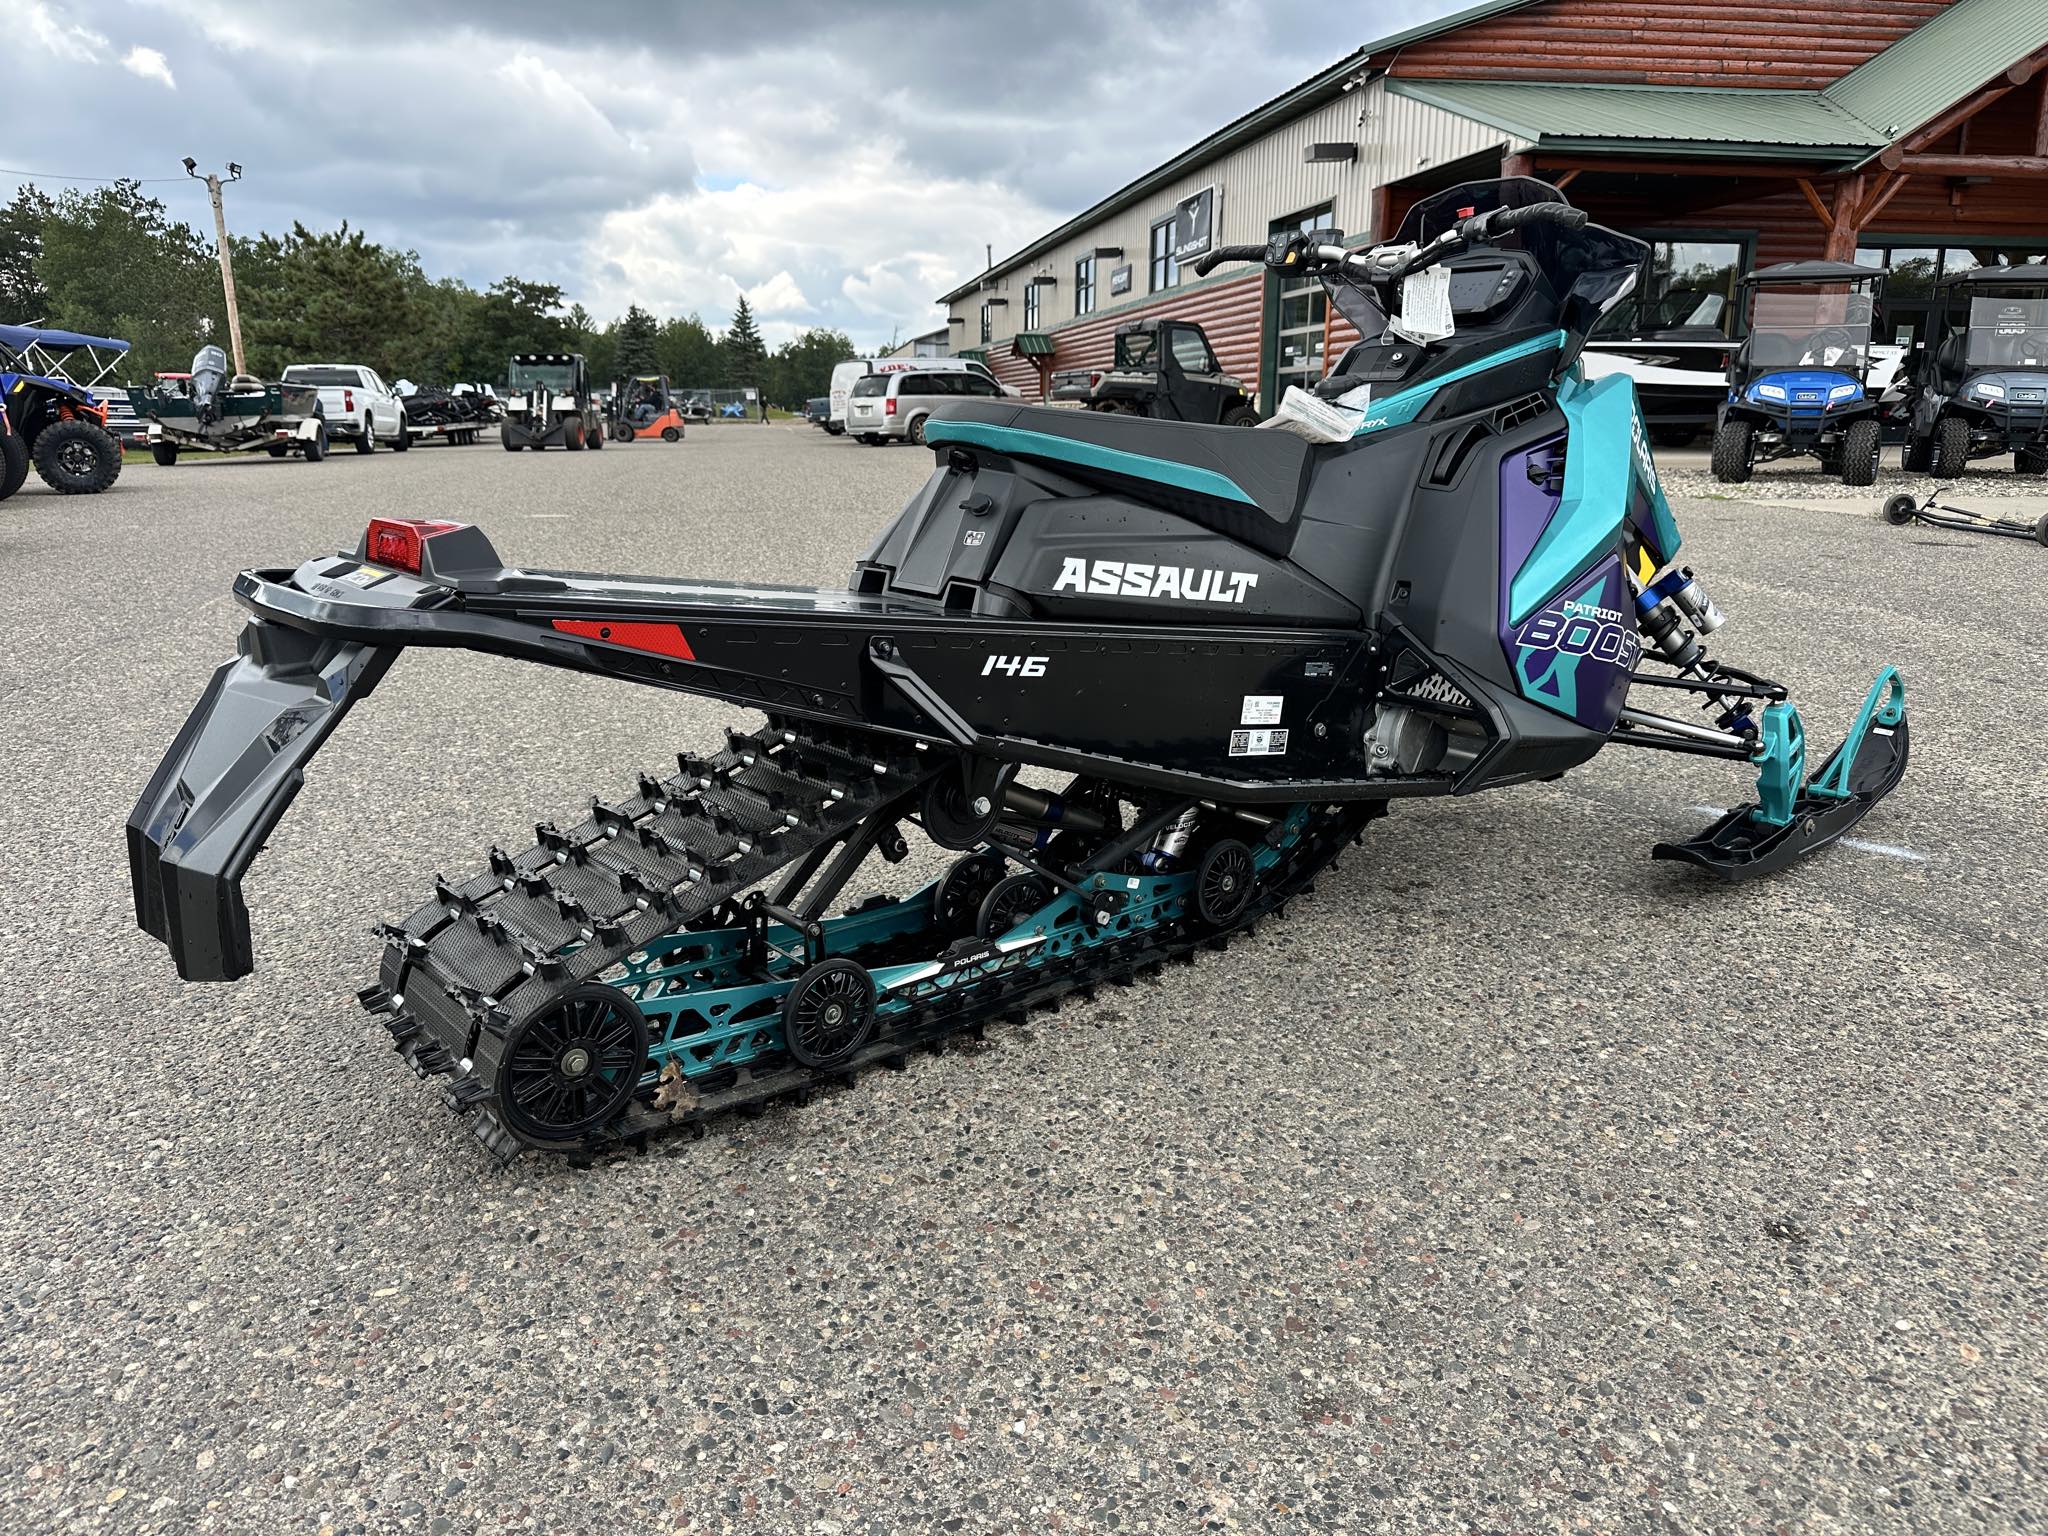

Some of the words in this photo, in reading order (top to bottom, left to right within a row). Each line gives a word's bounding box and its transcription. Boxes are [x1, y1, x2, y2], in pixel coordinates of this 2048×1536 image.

[1175, 236, 1208, 256] SLINGSHOT
[1359, 416, 1389, 430] RYX
[1052, 556, 1259, 604] ASSAULT
[1563, 600, 1623, 623] PATRIOT
[980, 655, 1050, 677] 146
[1164, 820, 1196, 831] VELOCIT
[954, 950, 990, 967] POLARIS
